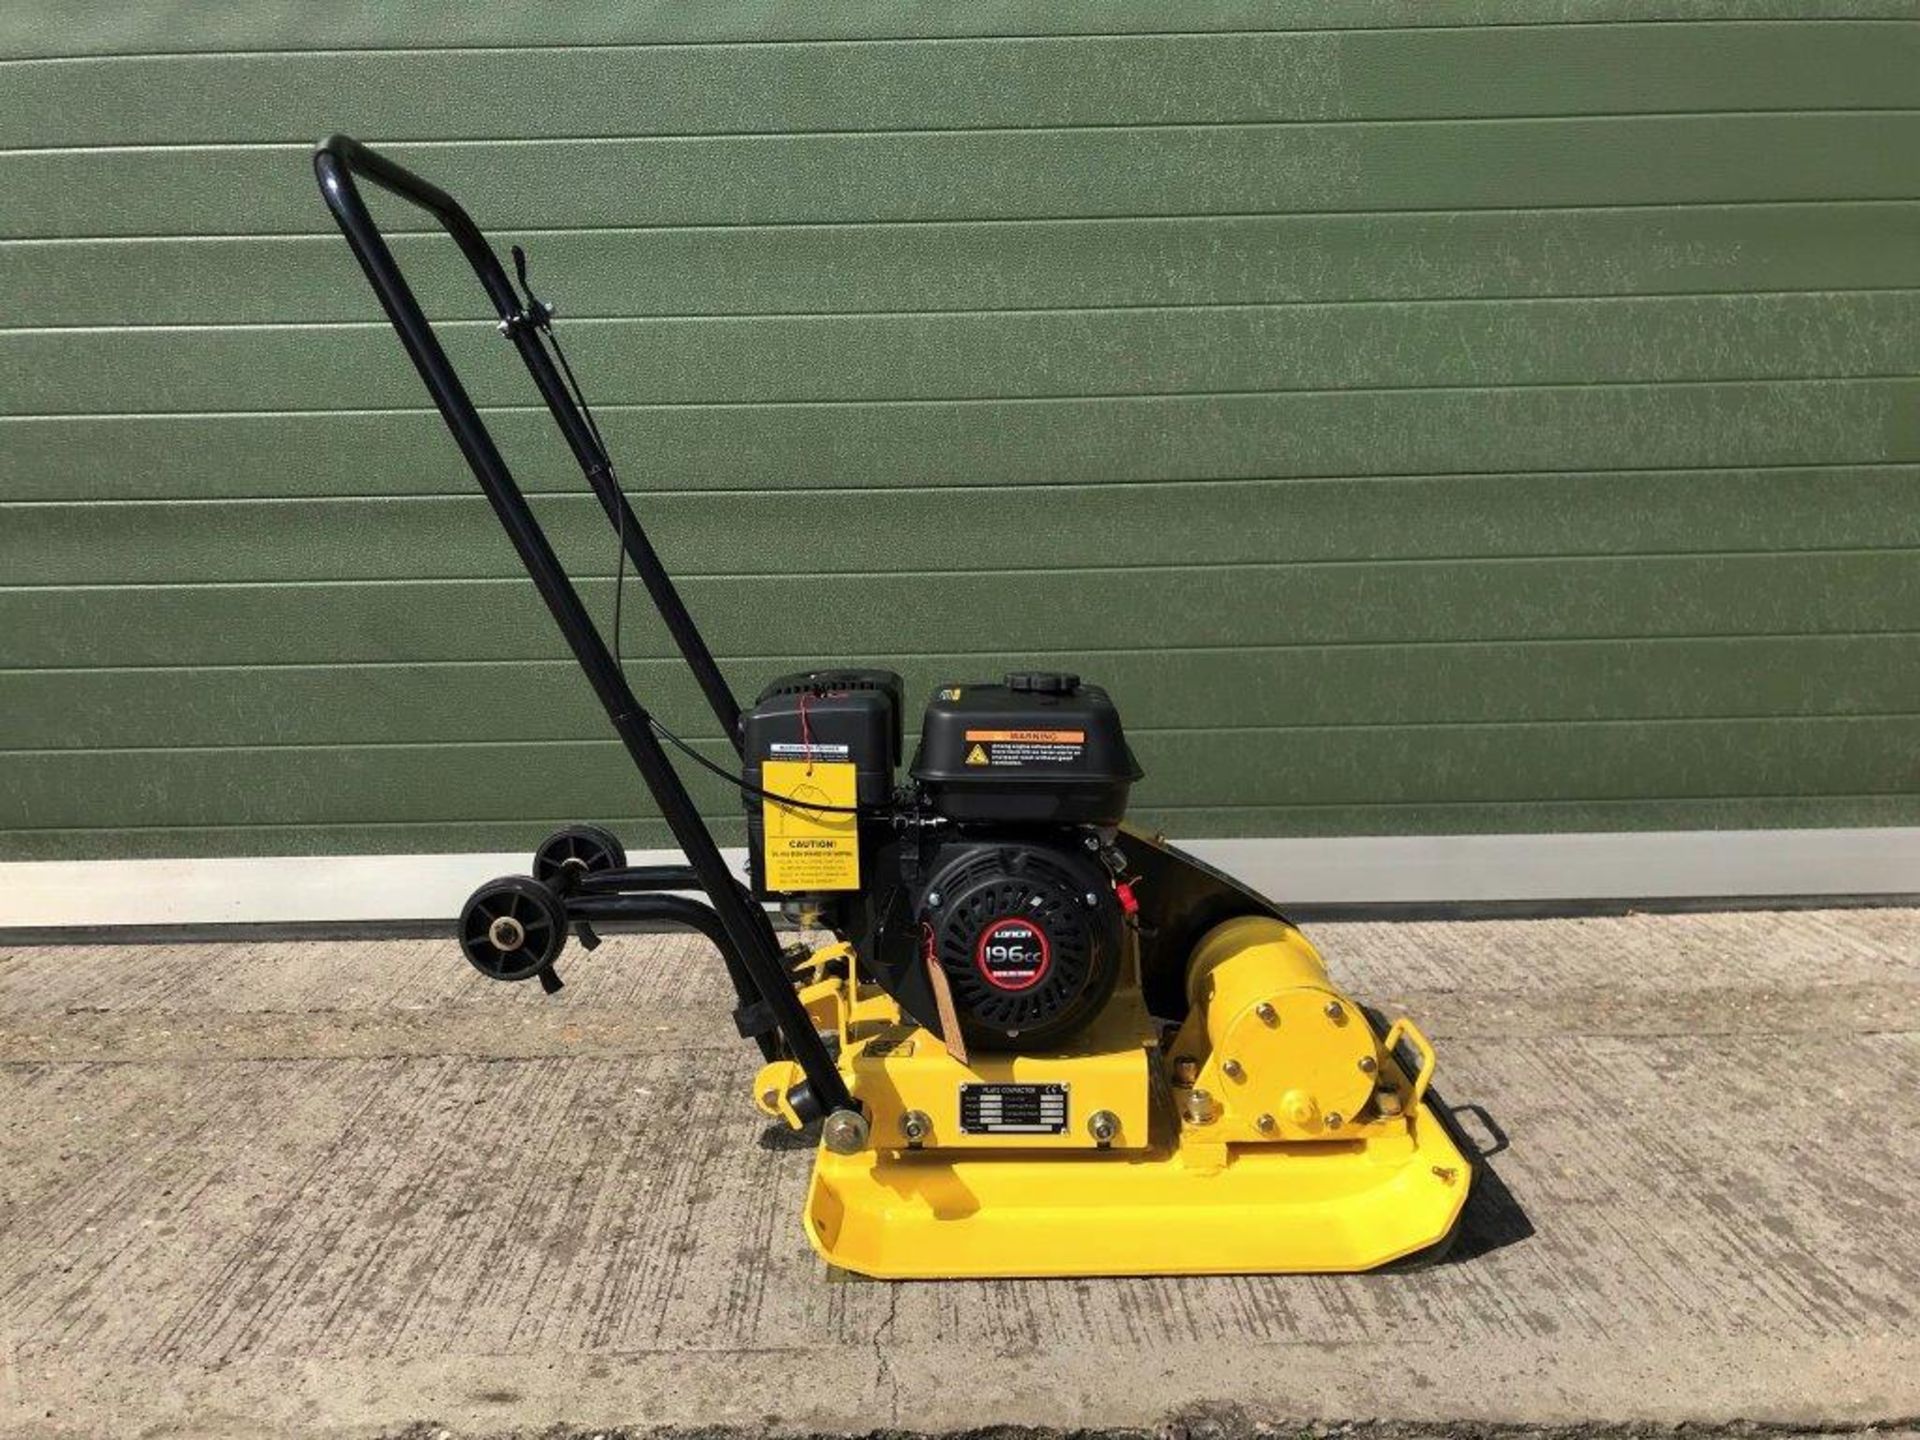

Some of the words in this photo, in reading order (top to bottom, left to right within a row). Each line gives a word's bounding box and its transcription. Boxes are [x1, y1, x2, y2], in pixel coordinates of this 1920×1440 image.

[1010, 732, 1058, 741] WARNING
[788, 840, 837, 849] CAUTION!
[994, 930, 1033, 939] LONCIN
[985, 945, 1042, 963] 196cc
